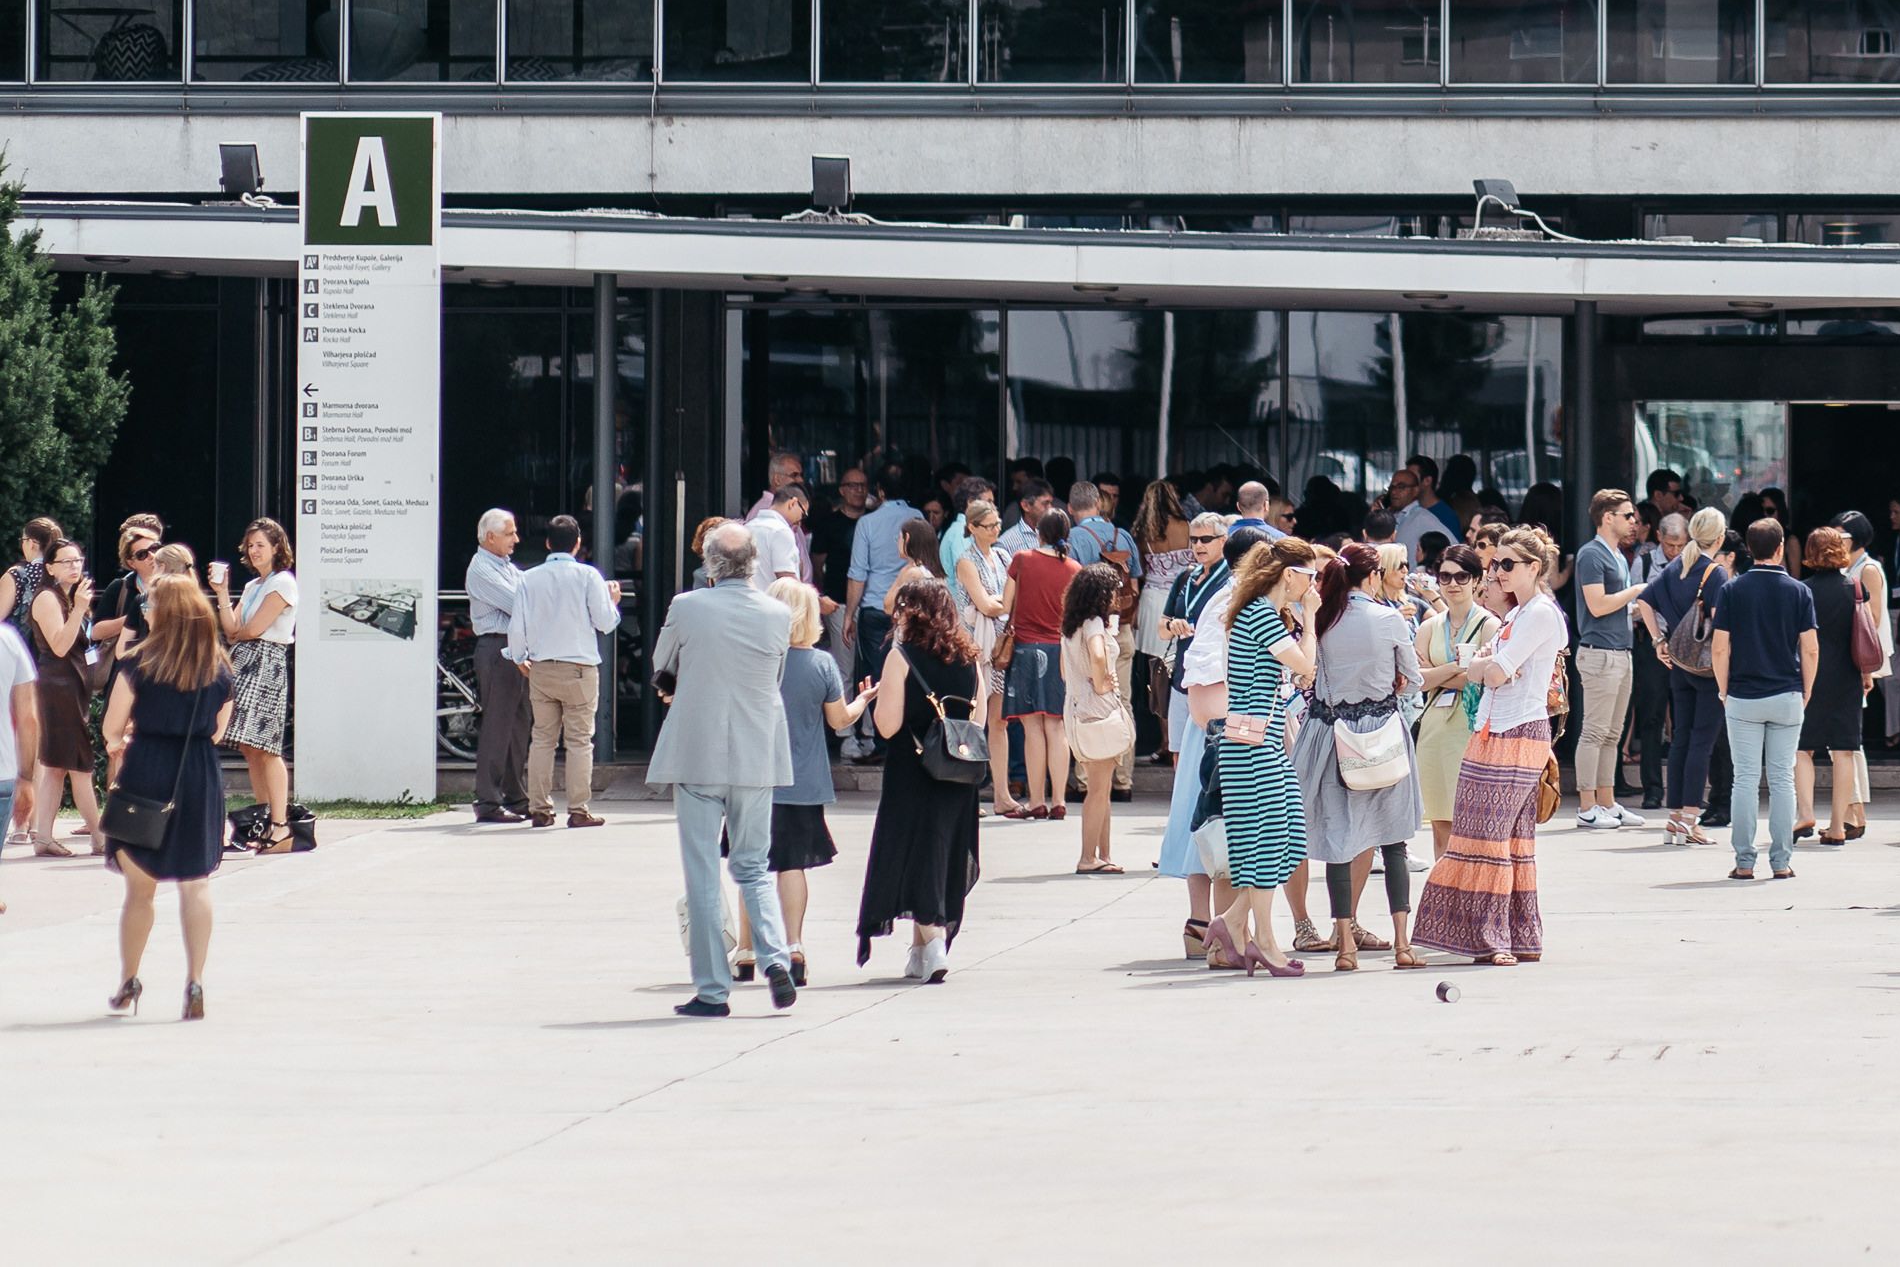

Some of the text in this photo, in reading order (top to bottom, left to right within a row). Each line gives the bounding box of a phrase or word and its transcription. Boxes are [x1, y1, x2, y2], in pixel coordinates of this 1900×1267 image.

[340, 136, 398, 227] A
[322, 253, 403, 263] Preddverje Kupole, Galerija
[343, 263, 354, 271] Hall
[322, 277, 370, 287] Dvorana Kupola
[307, 280, 315, 293] A
[322, 302, 375, 310] Steklena Dvorana
[307, 305, 315, 317] C
[322, 311, 358, 319] Steklena Hall
[322, 326, 366, 334] Dvorana Kocka
[322, 351, 353, 360] Vilharjeva
[354, 402, 379, 410] dvorana
[306, 404, 314, 417] B
[322, 426, 346, 434] Stebrna
[347, 426, 373, 434] Dvorana,
[375, 426, 399, 434] Povodni
[393, 435, 404, 443] Hall
[340, 459, 352, 467] Hall
[321, 474, 346, 482] Dvorana
[305, 501, 313, 513] G
[362, 499, 380, 507] Sonet,
[382, 499, 403, 507] Gazela,
[321, 523, 348, 531] Dunajska
